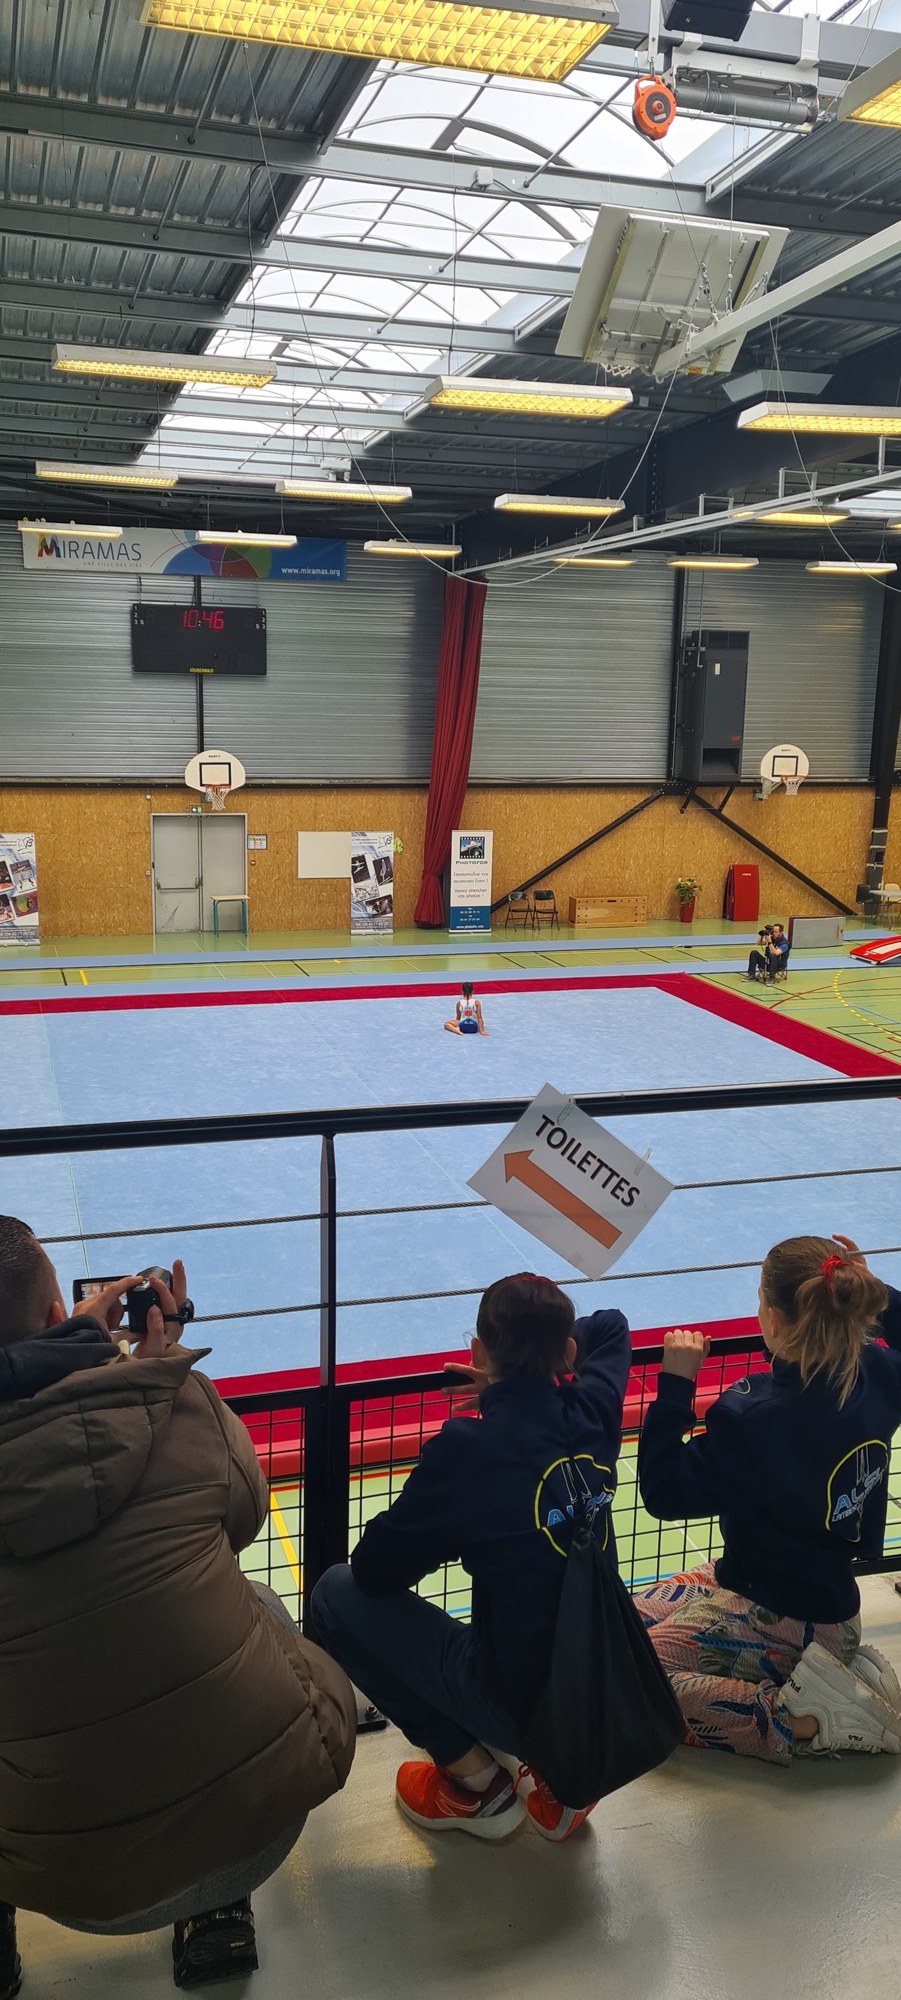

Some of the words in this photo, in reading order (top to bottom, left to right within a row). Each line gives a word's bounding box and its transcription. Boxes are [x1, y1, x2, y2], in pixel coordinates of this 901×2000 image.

[37, 533, 142, 561] MIRAMAS
[281, 567, 341, 577] www.miramas.org
[182, 610, 225, 630] 10:46
[535, 1114, 641, 1207] TOILETTES
